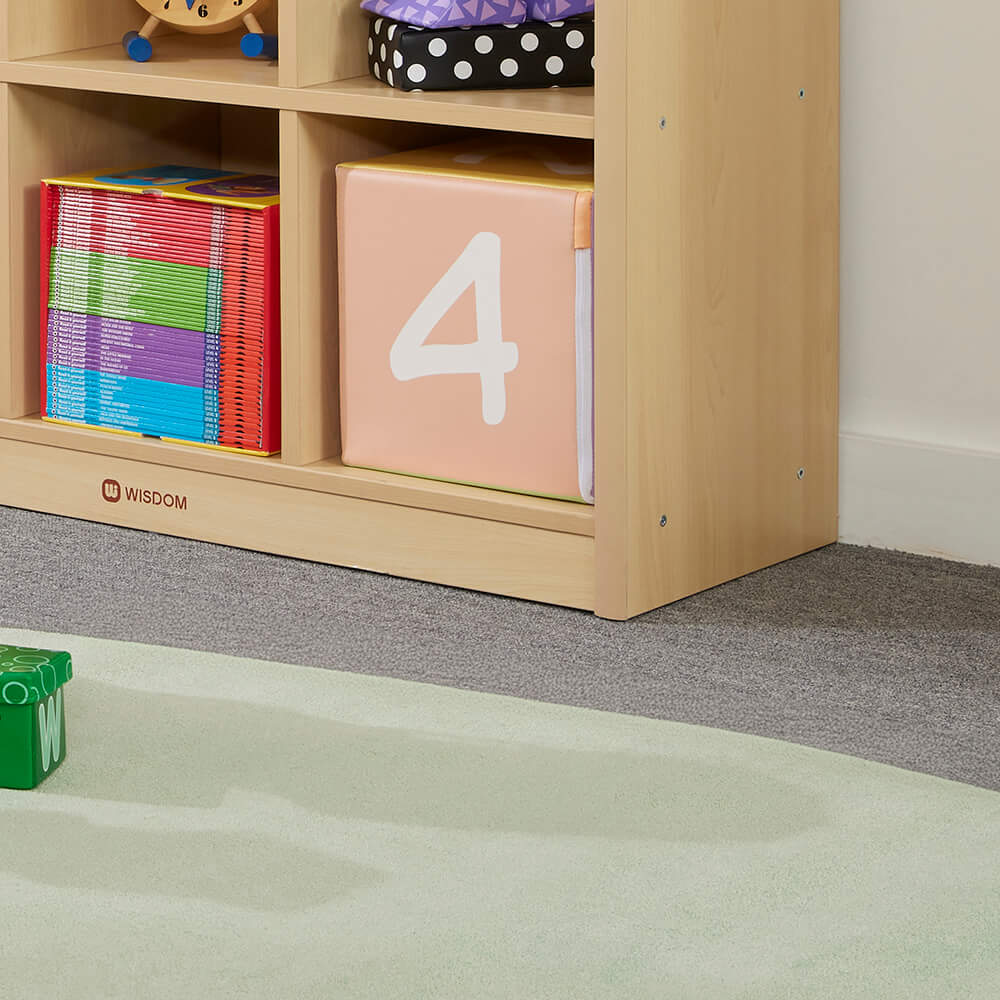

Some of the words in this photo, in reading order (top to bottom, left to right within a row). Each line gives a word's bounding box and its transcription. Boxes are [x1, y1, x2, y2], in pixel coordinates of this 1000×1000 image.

[198, 5, 208, 18] 6
[390, 231, 519, 425] 4
[125, 486, 187, 510] WISDOM
